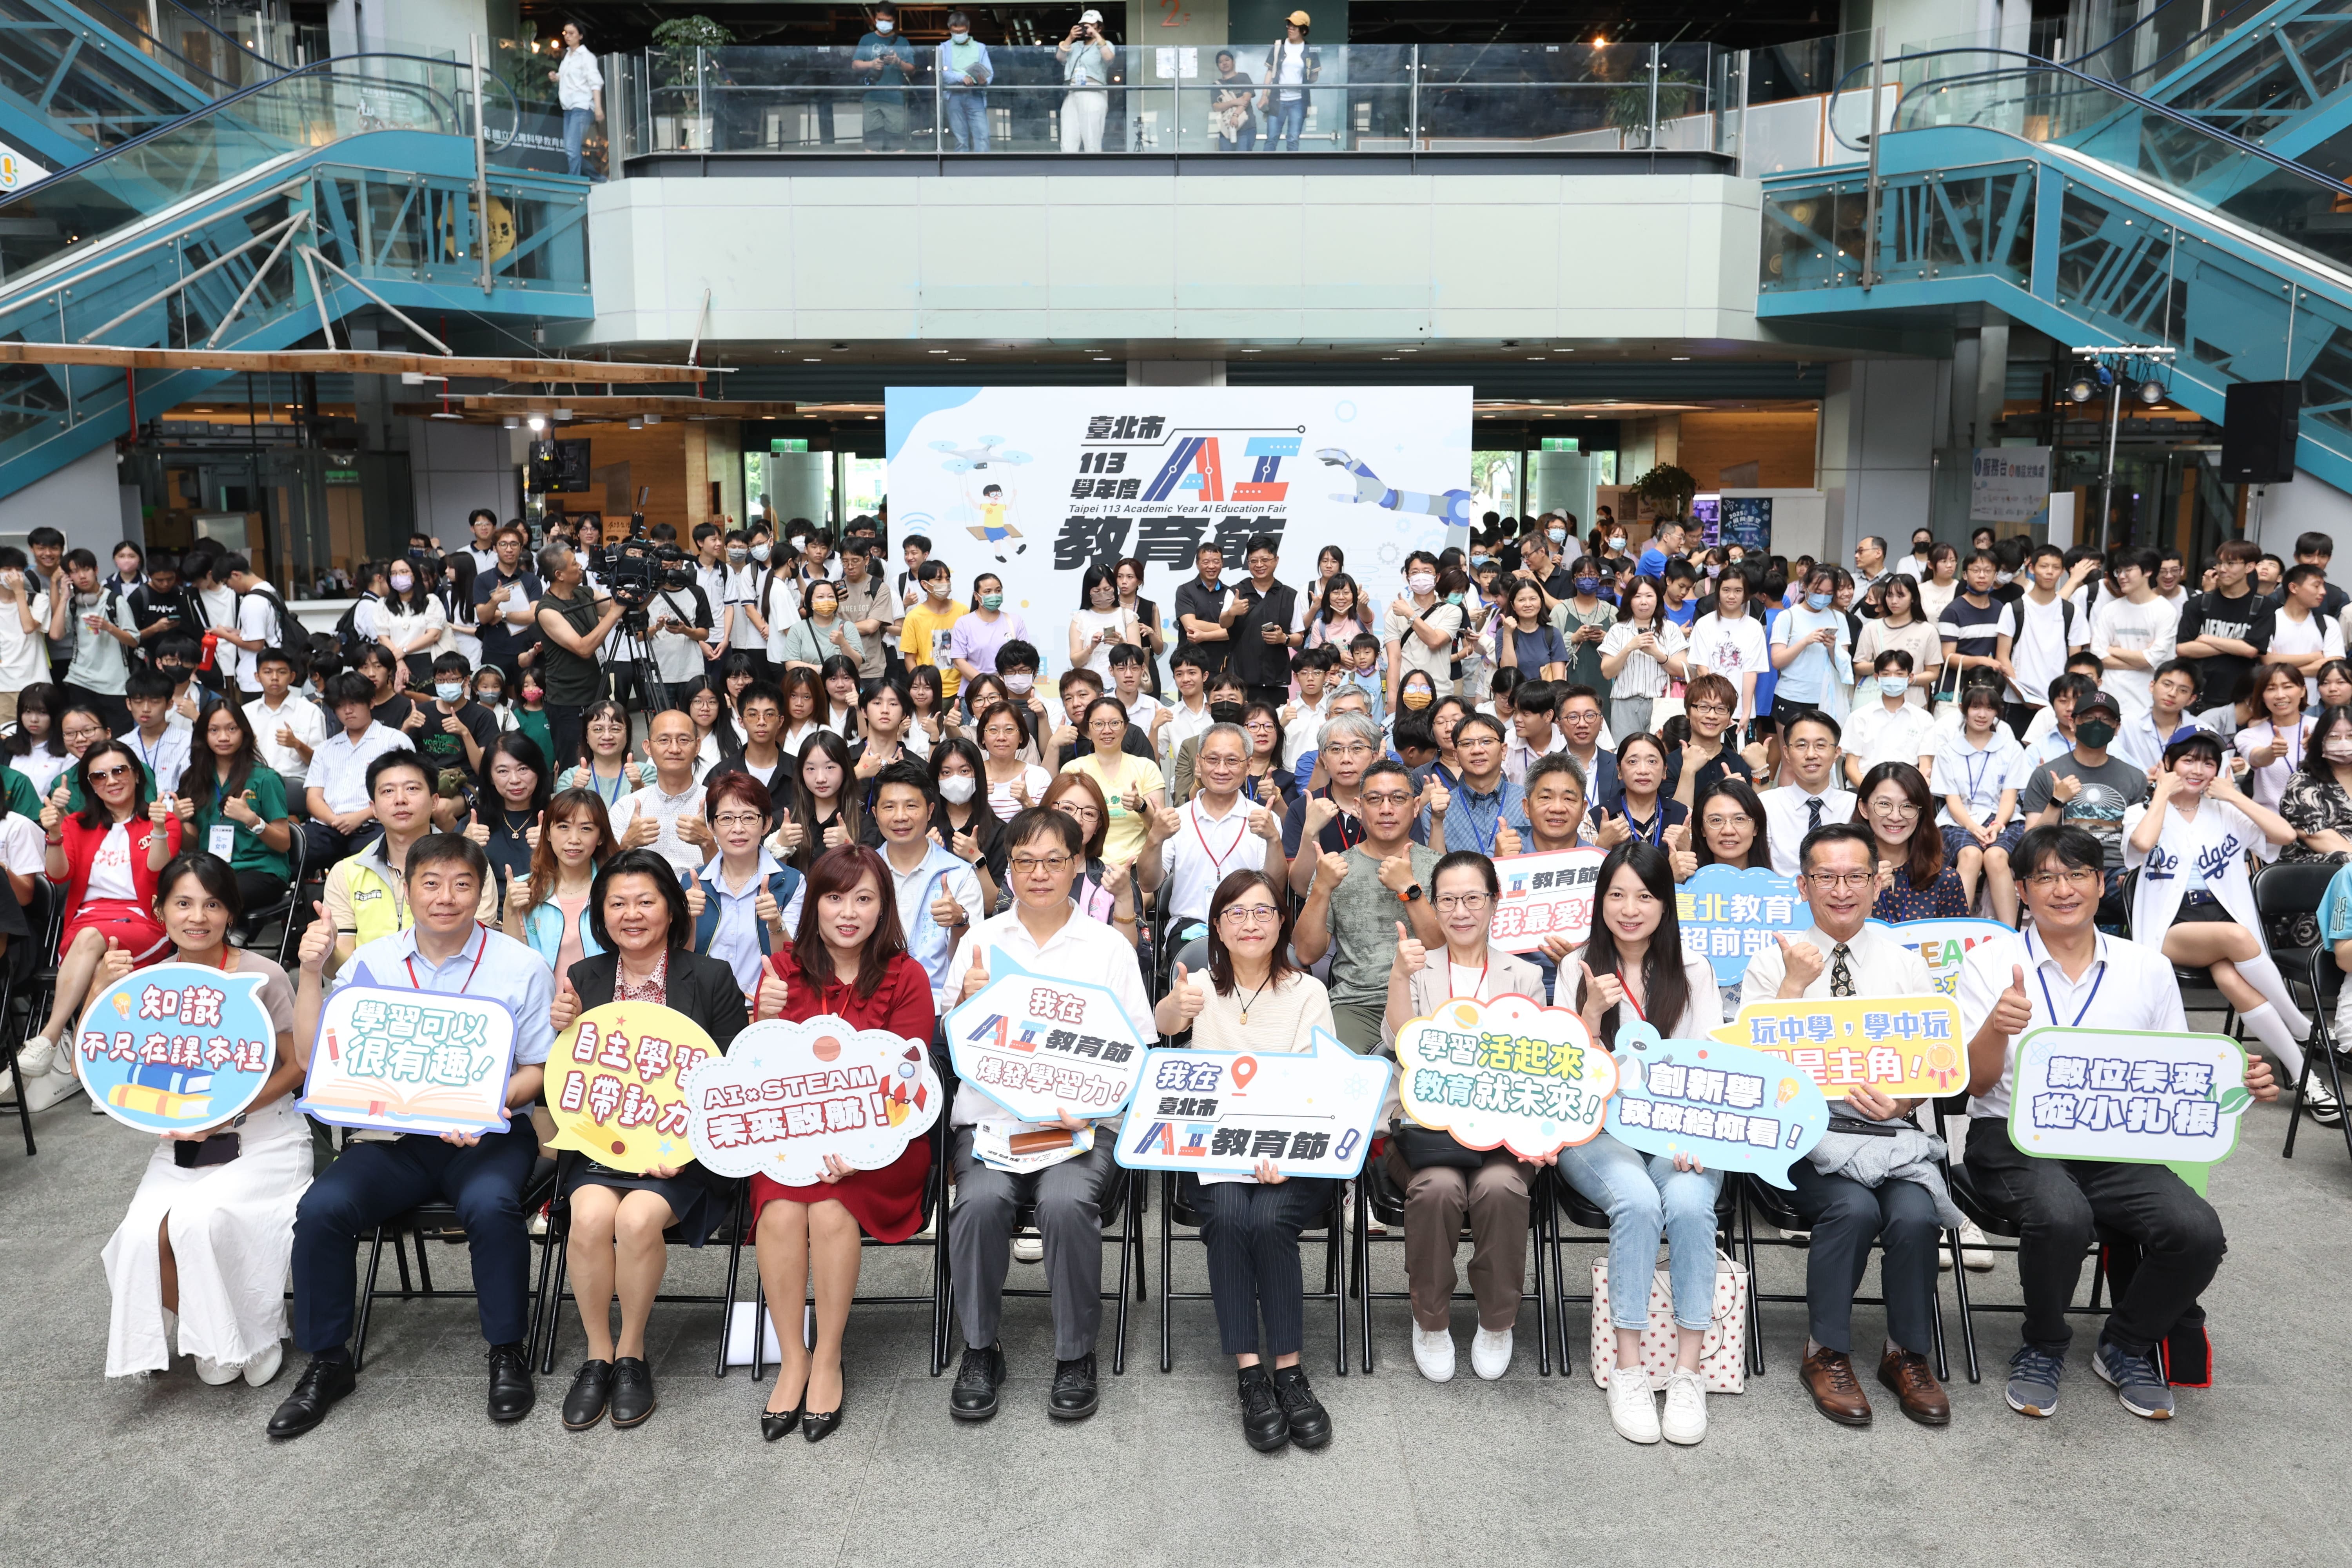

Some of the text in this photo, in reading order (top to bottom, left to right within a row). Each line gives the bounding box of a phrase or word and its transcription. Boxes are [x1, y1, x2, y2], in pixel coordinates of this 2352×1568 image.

[1085, 416, 1166, 439] 臺北市
[1079, 452, 1127, 474] 113
[1140, 437, 1303, 501] AI
[1069, 505, 1287, 515] Taipei 113 Academic Year AI Education Fair
[1070, 479, 1142, 499] 學年度
[1728, 510, 1744, 520] 2025
[1053, 515, 1287, 571] 教育節
[1675, 891, 1795, 926] 臺北教育
[140, 984, 226, 1027] 知識
[352, 999, 488, 1046] 學習可以
[1029, 987, 1086, 1024] 我在
[81, 1032, 267, 1074] 不只在課本裡
[347, 1036, 494, 1087] 很有趣!
[573, 1022, 708, 1091] 自主學習
[1419, 1029, 1585, 1081] 學習活起來
[975, 1056, 1128, 1107] 爆發學習力!
[1156, 1060, 1223, 1092] 我在
[1413, 1069, 1601, 1125] 教育就未來!
[1646, 1062, 1766, 1109] 創新學
[2046, 1055, 2214, 1097] 數位未來
[560, 1070, 692, 1137] 自帶動力
[1157, 1097, 1219, 1117] 臺北市
[2033, 1091, 2220, 1138] 從小扎根
